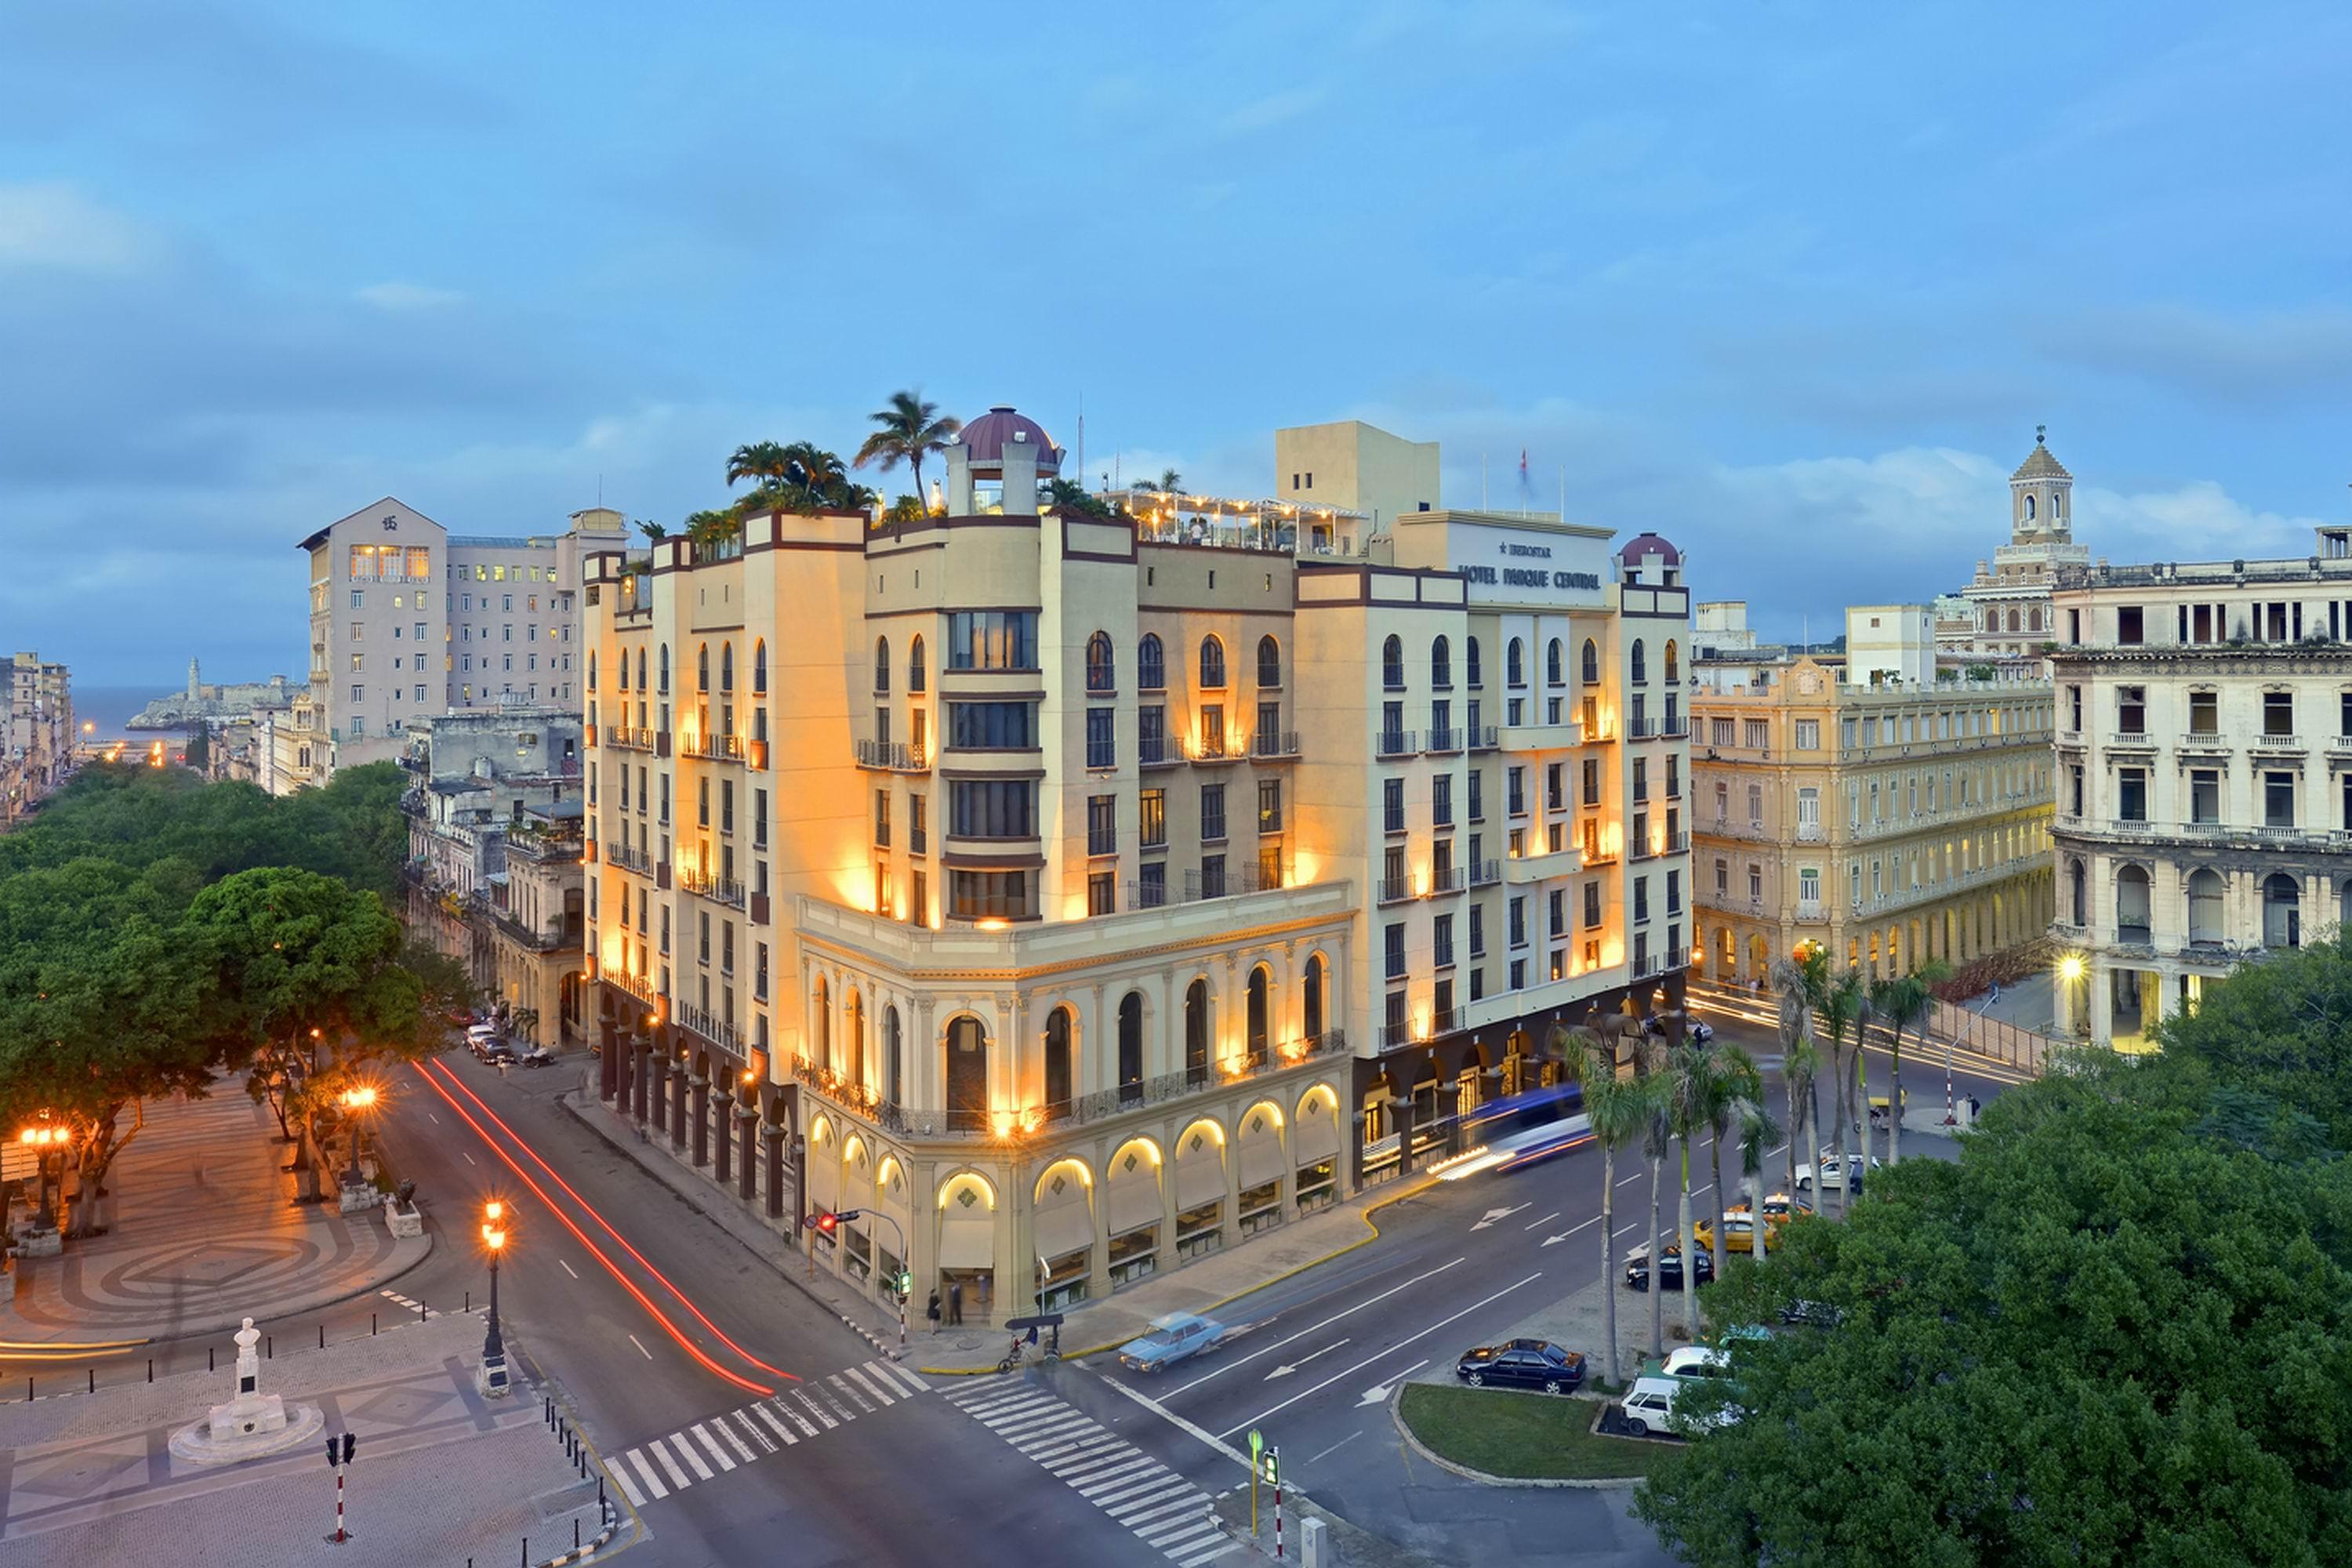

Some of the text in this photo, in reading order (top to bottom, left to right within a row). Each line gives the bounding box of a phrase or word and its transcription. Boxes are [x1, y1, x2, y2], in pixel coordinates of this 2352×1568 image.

[1509, 544, 1551, 558] IBEROSTAR
[1504, 568, 1550, 587] PARQUE
[1553, 572, 1601, 590] CENTRAL
